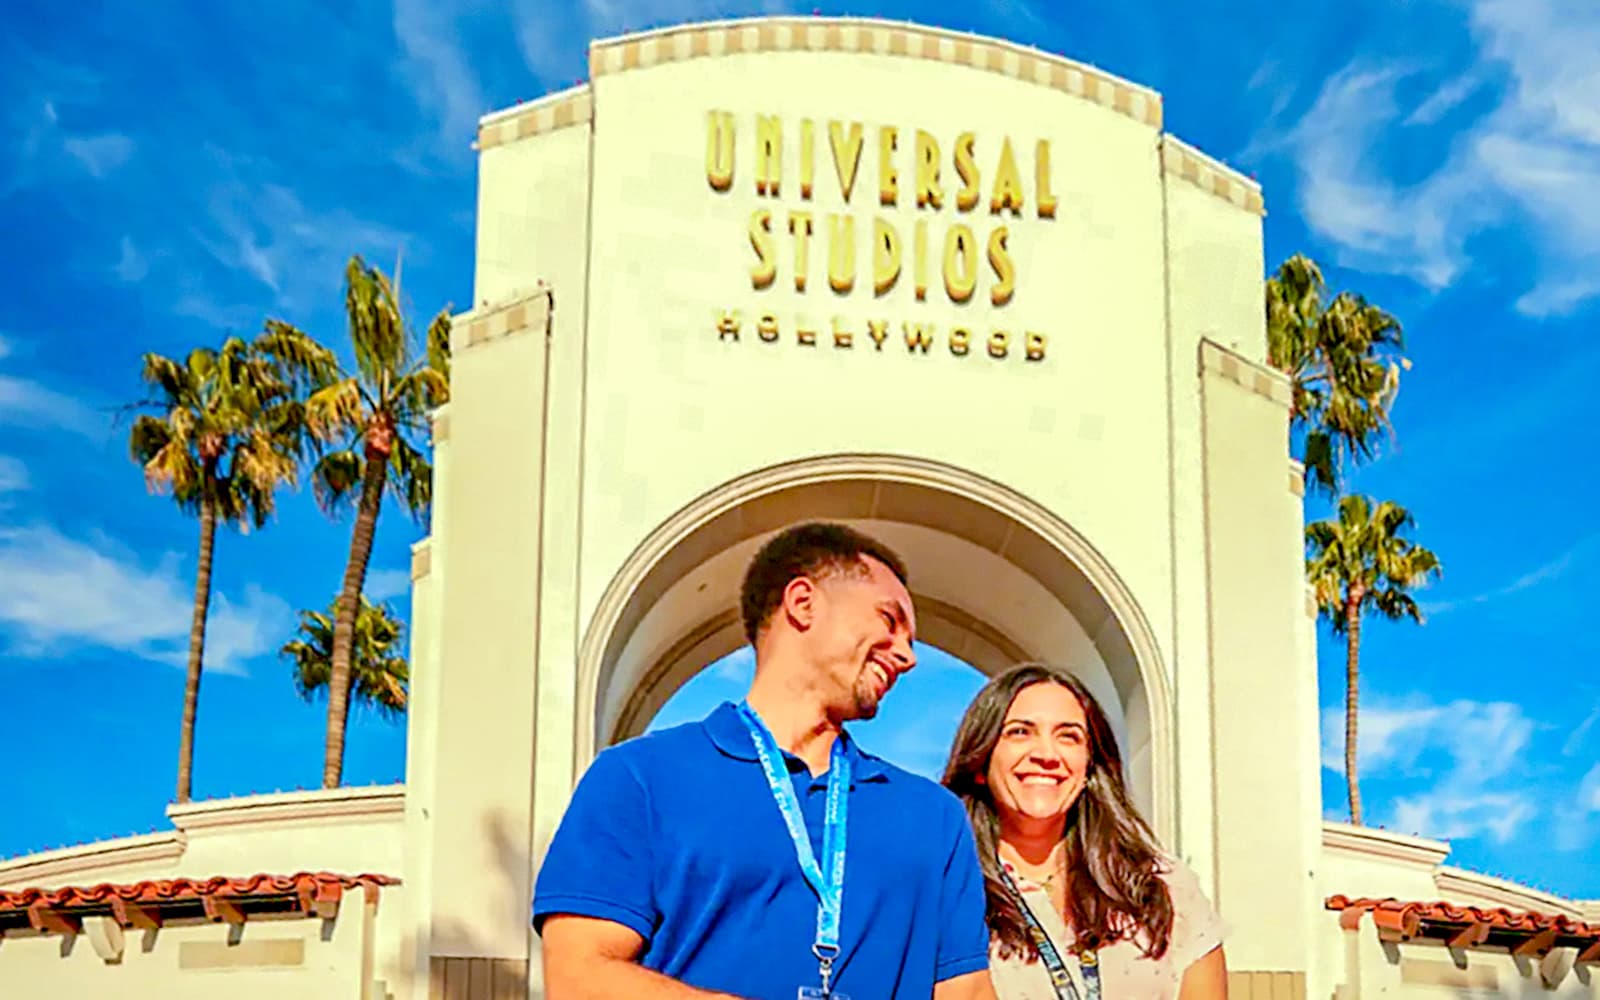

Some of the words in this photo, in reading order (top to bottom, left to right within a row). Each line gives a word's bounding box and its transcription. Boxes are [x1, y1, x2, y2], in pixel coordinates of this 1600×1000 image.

[706, 109, 1058, 220] UNIVERSAL
[748, 209, 1017, 307] STUDIOS
[716, 309, 1047, 362] HOLLYWOOD
